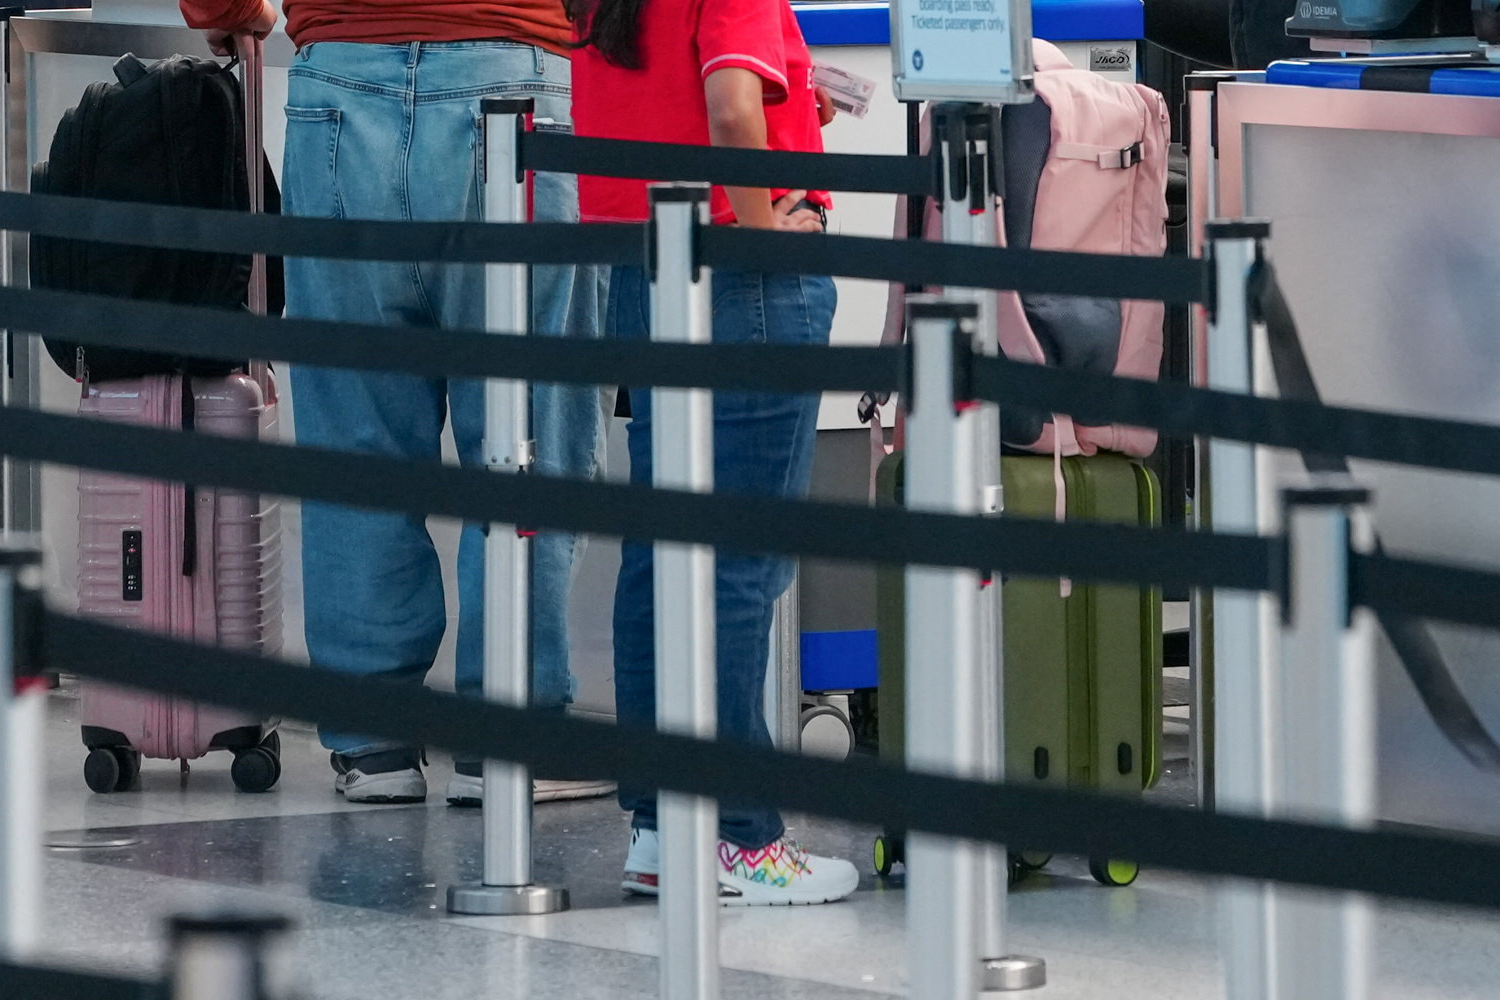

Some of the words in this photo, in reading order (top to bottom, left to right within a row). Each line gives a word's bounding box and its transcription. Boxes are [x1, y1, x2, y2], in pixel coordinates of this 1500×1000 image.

[954, 0, 971, 13] pass
[1312, 6, 1338, 16] IDEMIA
[911, 14, 943, 30] Ticketed
[945, 17, 986, 32] passengers
[1095, 55, 1125, 64] JACO
